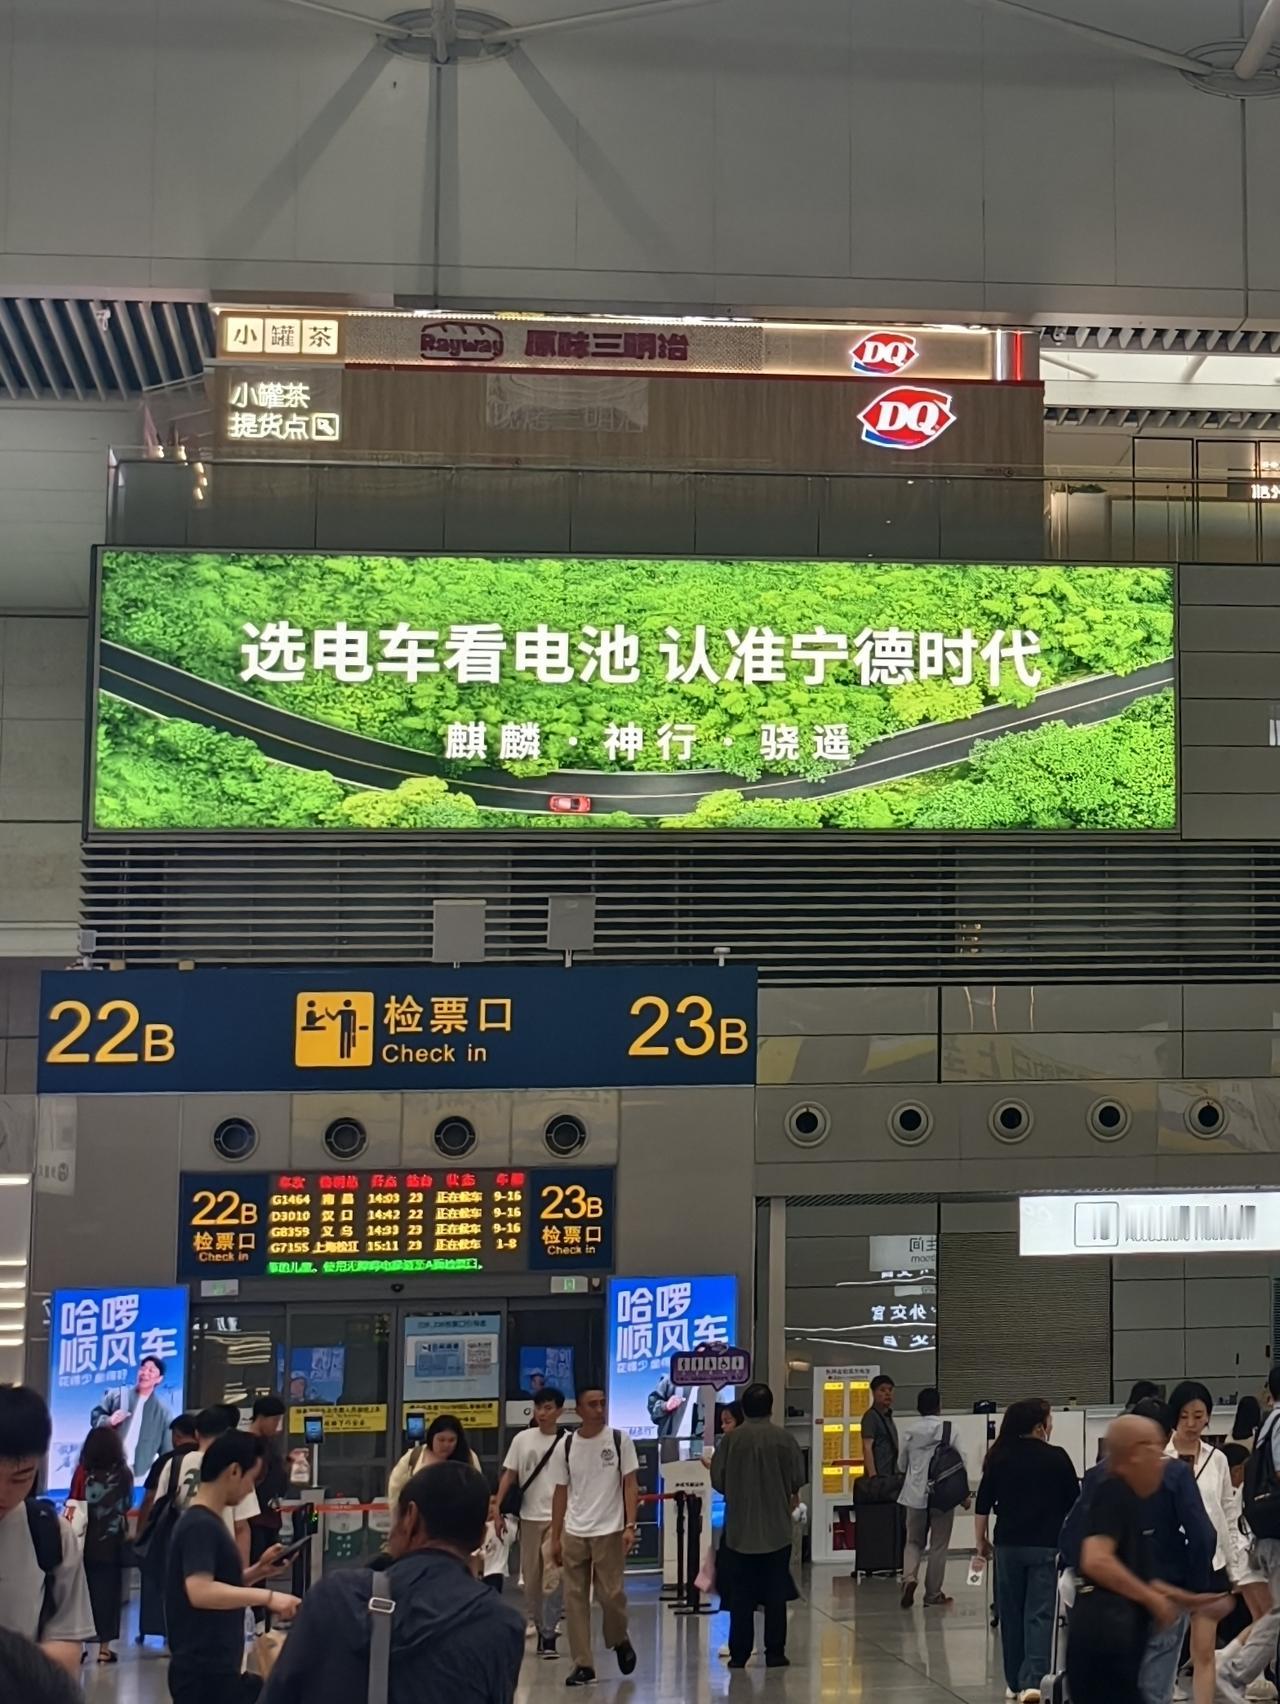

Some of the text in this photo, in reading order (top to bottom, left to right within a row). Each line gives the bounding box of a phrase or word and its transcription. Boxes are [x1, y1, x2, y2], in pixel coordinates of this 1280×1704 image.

[233, 324, 333, 347] 小罐茶
[420, 333, 502, 356] Rayway
[524, 330, 689, 360] 原味三明治
[862, 341, 908, 367] DQ
[229, 382, 310, 408] 小罐茶
[227, 412, 310, 439] 提货点
[876, 401, 940, 436] DQ
[239, 621, 1042, 687] 选电车看电池 认准宁德时代
[383, 995, 512, 1035] 检票口
[628, 996, 749, 1056] 23B
[46, 1000, 175, 1063] 22B
[382, 1044, 487, 1063] Check in
[191, 1190, 258, 1225] 22B
[271, 1194, 311, 1206] G1464
[407, 1193, 424, 1204] 23
[493, 1190, 522, 1202] 9-16
[540, 1185, 603, 1219] 23B
[271, 1210, 311, 1222] D3010
[321, 1210, 353, 1222] 汉口
[367, 1209, 401, 1221] 14:42
[407, 1209, 424, 1220] 22
[493, 1207, 522, 1218] 9-16
[193, 1231, 256, 1250] 检票口
[320, 1225, 354, 1238] 义乌
[407, 1225, 423, 1236] 23
[542, 1225, 602, 1245] 检票口
[199, 1252, 249, 1262] Check in
[270, 1242, 310, 1253] G7155
[366, 1241, 399, 1252] 15:11
[407, 1240, 423, 1251] 23
[496, 1239, 517, 1250] 1-8
[547, 1244, 596, 1255] Check in
[61, 1294, 140, 1337] 哈啰
[617, 1282, 692, 1324] 哈啰
[616, 1314, 729, 1361] 顺风车
[59, 1327, 178, 1376] 顺风车
